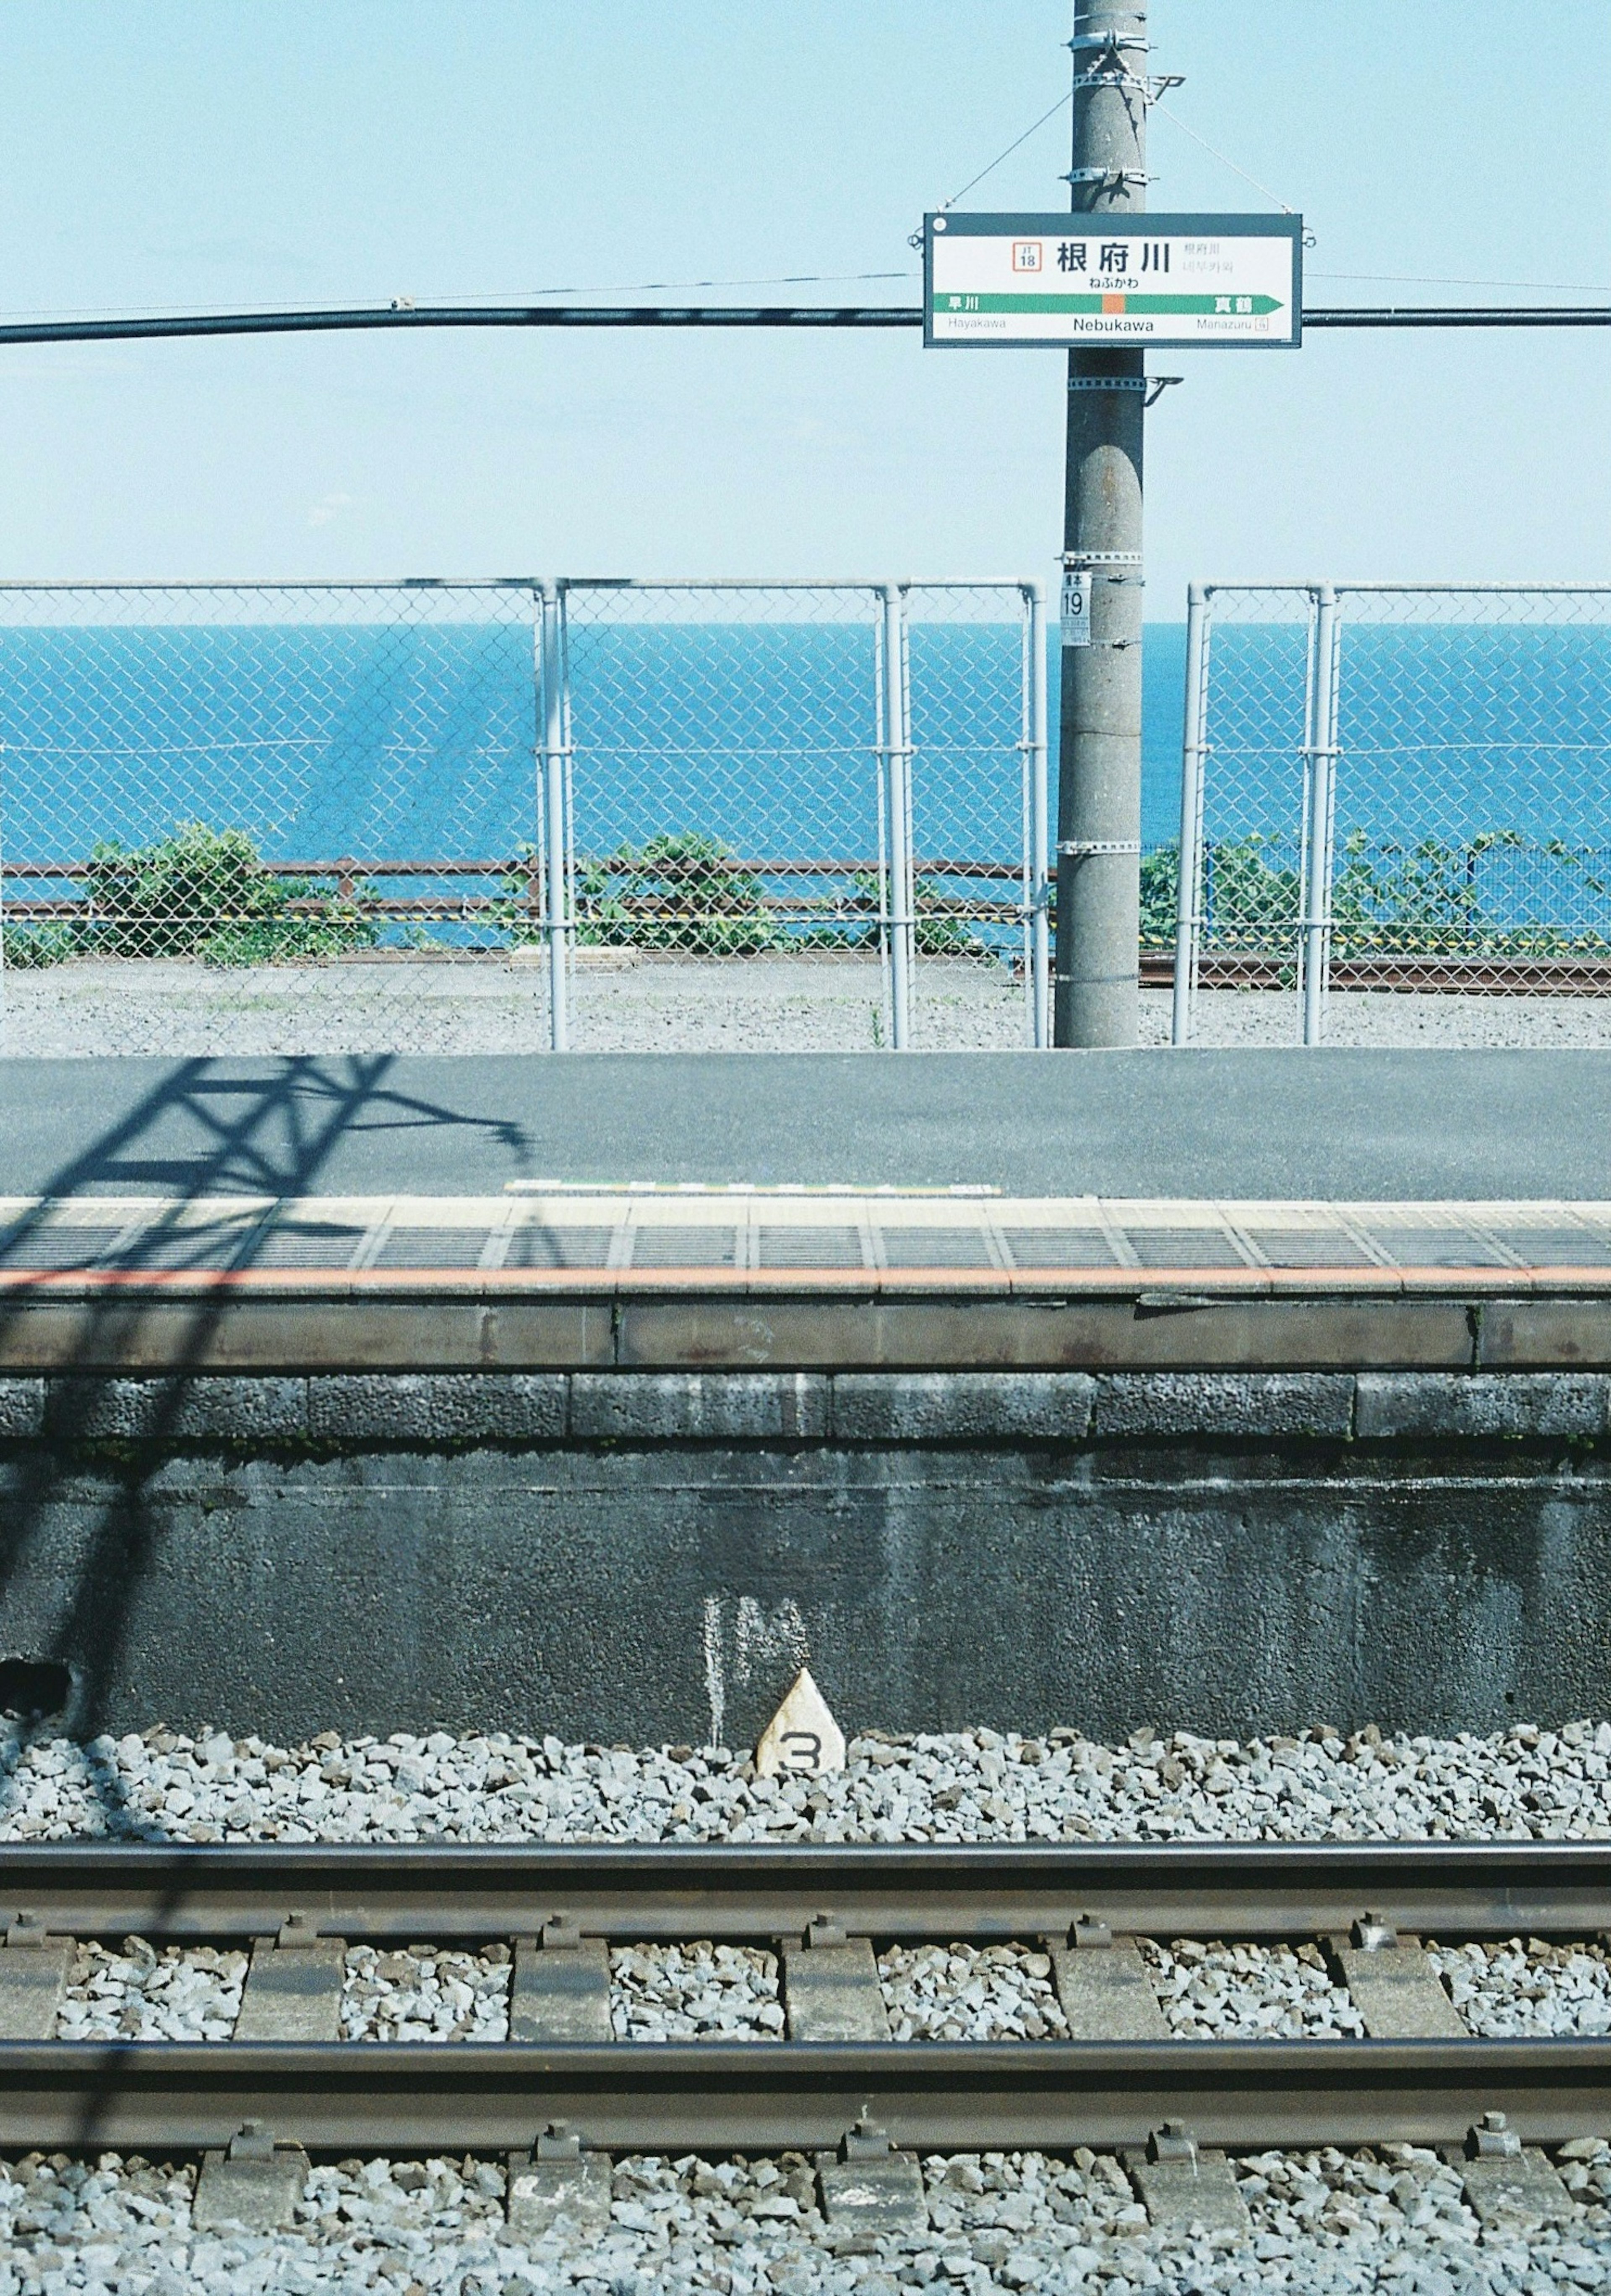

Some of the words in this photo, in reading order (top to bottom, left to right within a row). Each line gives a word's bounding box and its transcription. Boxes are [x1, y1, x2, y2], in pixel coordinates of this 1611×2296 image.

[1020, 255, 1035, 267] 18
[1057, 243, 1170, 273] 根府川
[1090, 277, 1139, 288] ねぶかわ
[948, 296, 979, 310] 早川
[948, 318, 1006, 330] Hayakawa
[1074, 318, 1154, 331] Nebukawa
[1197, 318, 1251, 329] Manazuru
[1064, 592, 1083, 616] 19
[778, 1731, 822, 1771] 3
